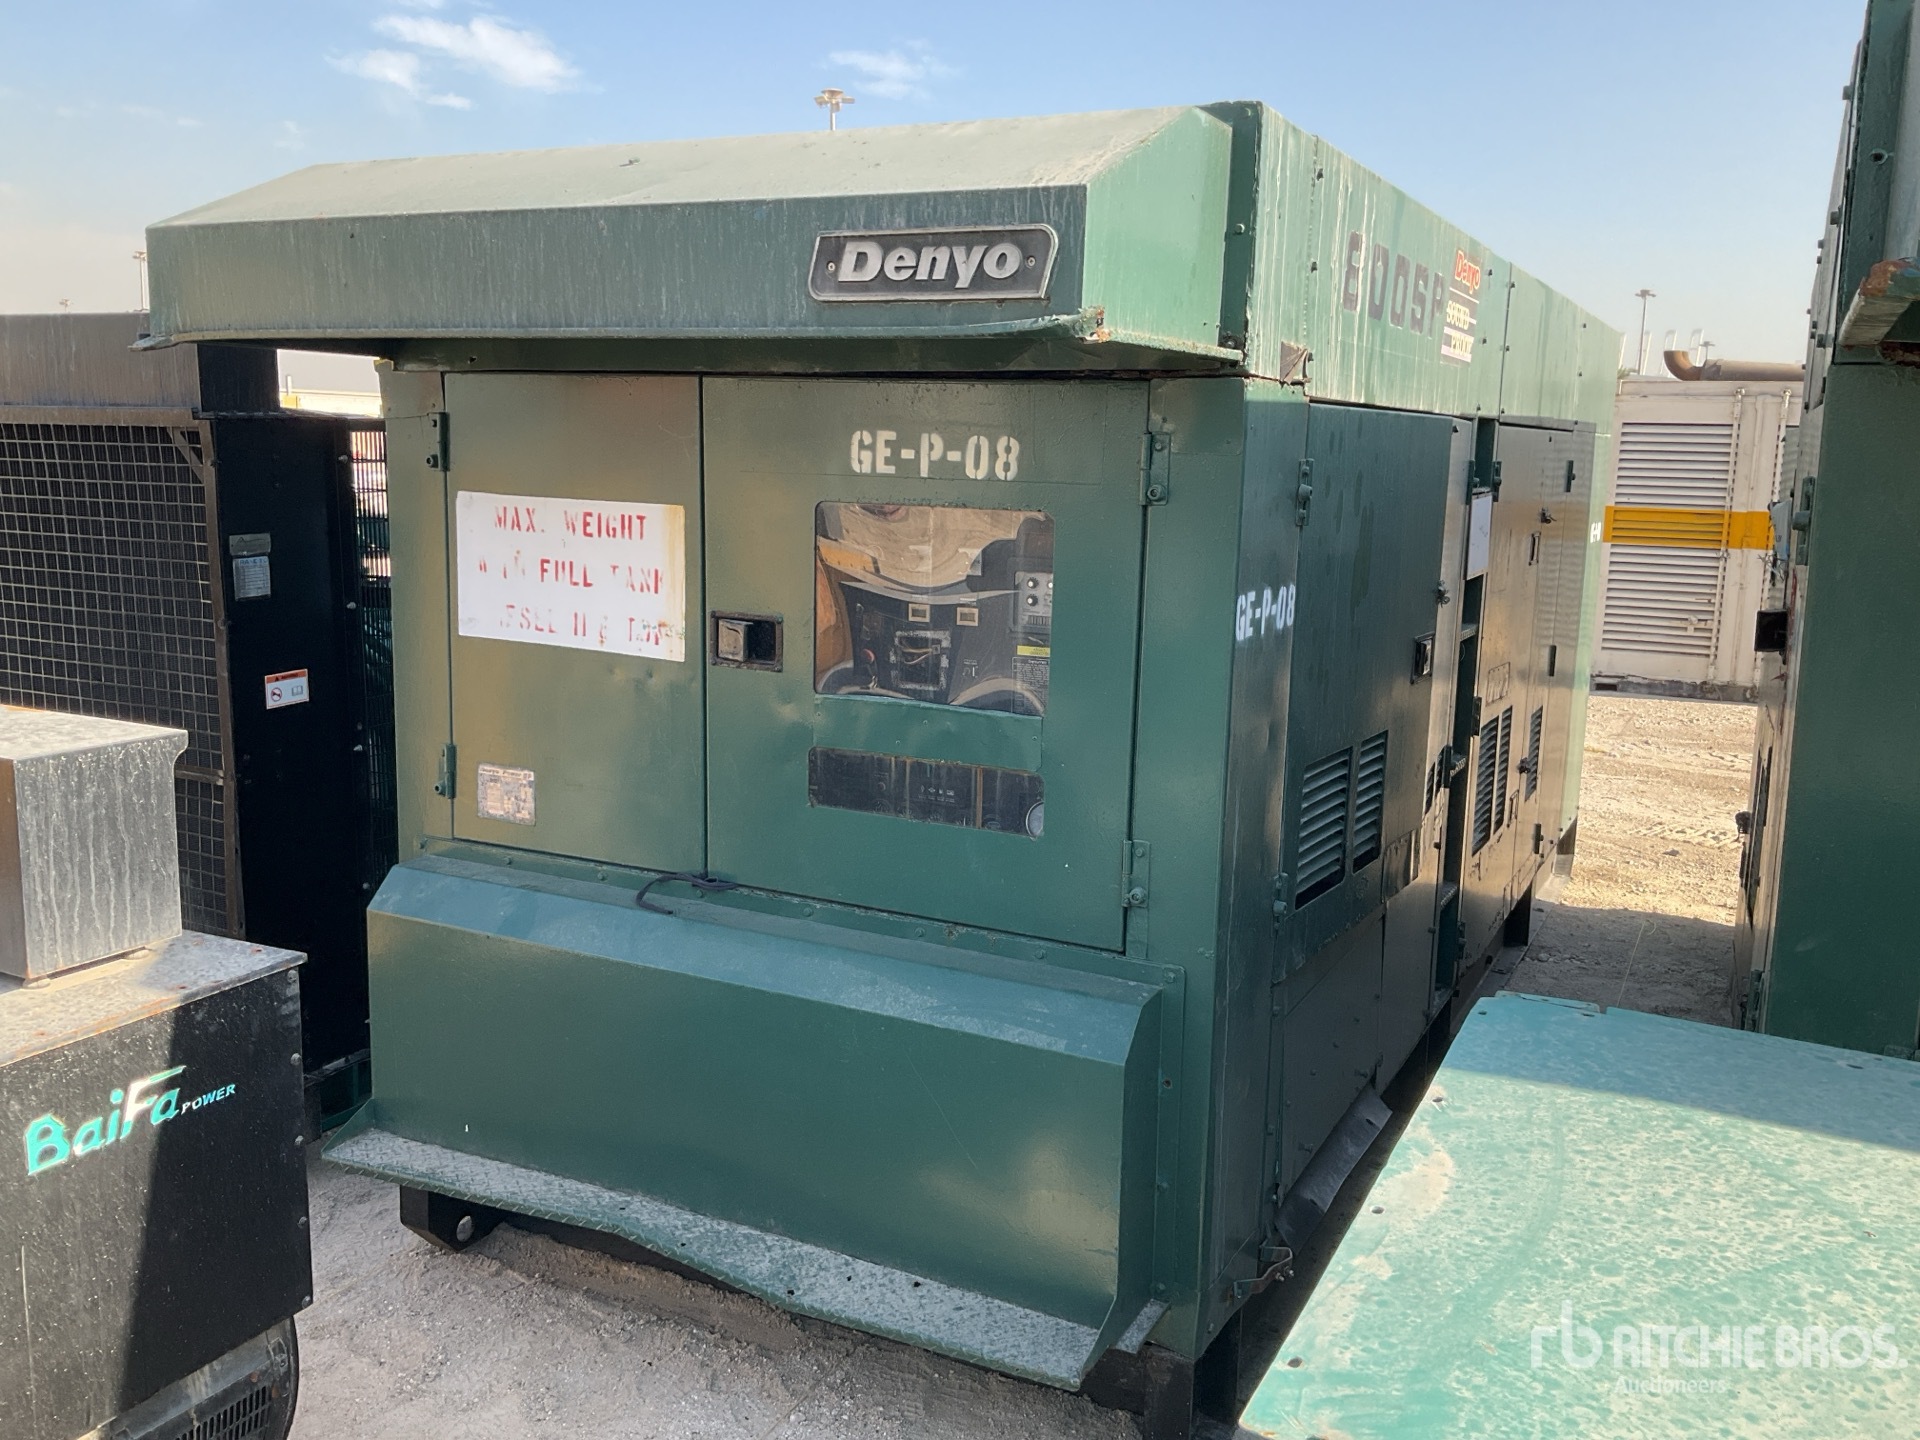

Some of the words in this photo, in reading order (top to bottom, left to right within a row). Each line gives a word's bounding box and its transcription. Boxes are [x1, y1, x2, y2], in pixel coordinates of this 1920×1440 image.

[837, 241, 1021, 289] Denyo
[850, 430, 1020, 481] GE-P-08
[494, 505, 545, 533] MAX.
[563, 509, 647, 541] WEIGHT
[539, 558, 594, 588] FULL
[1235, 584, 1296, 641] GE-P-08
[25, 1065, 187, 1175] BaiFa
[181, 1083, 237, 1115] POWER
